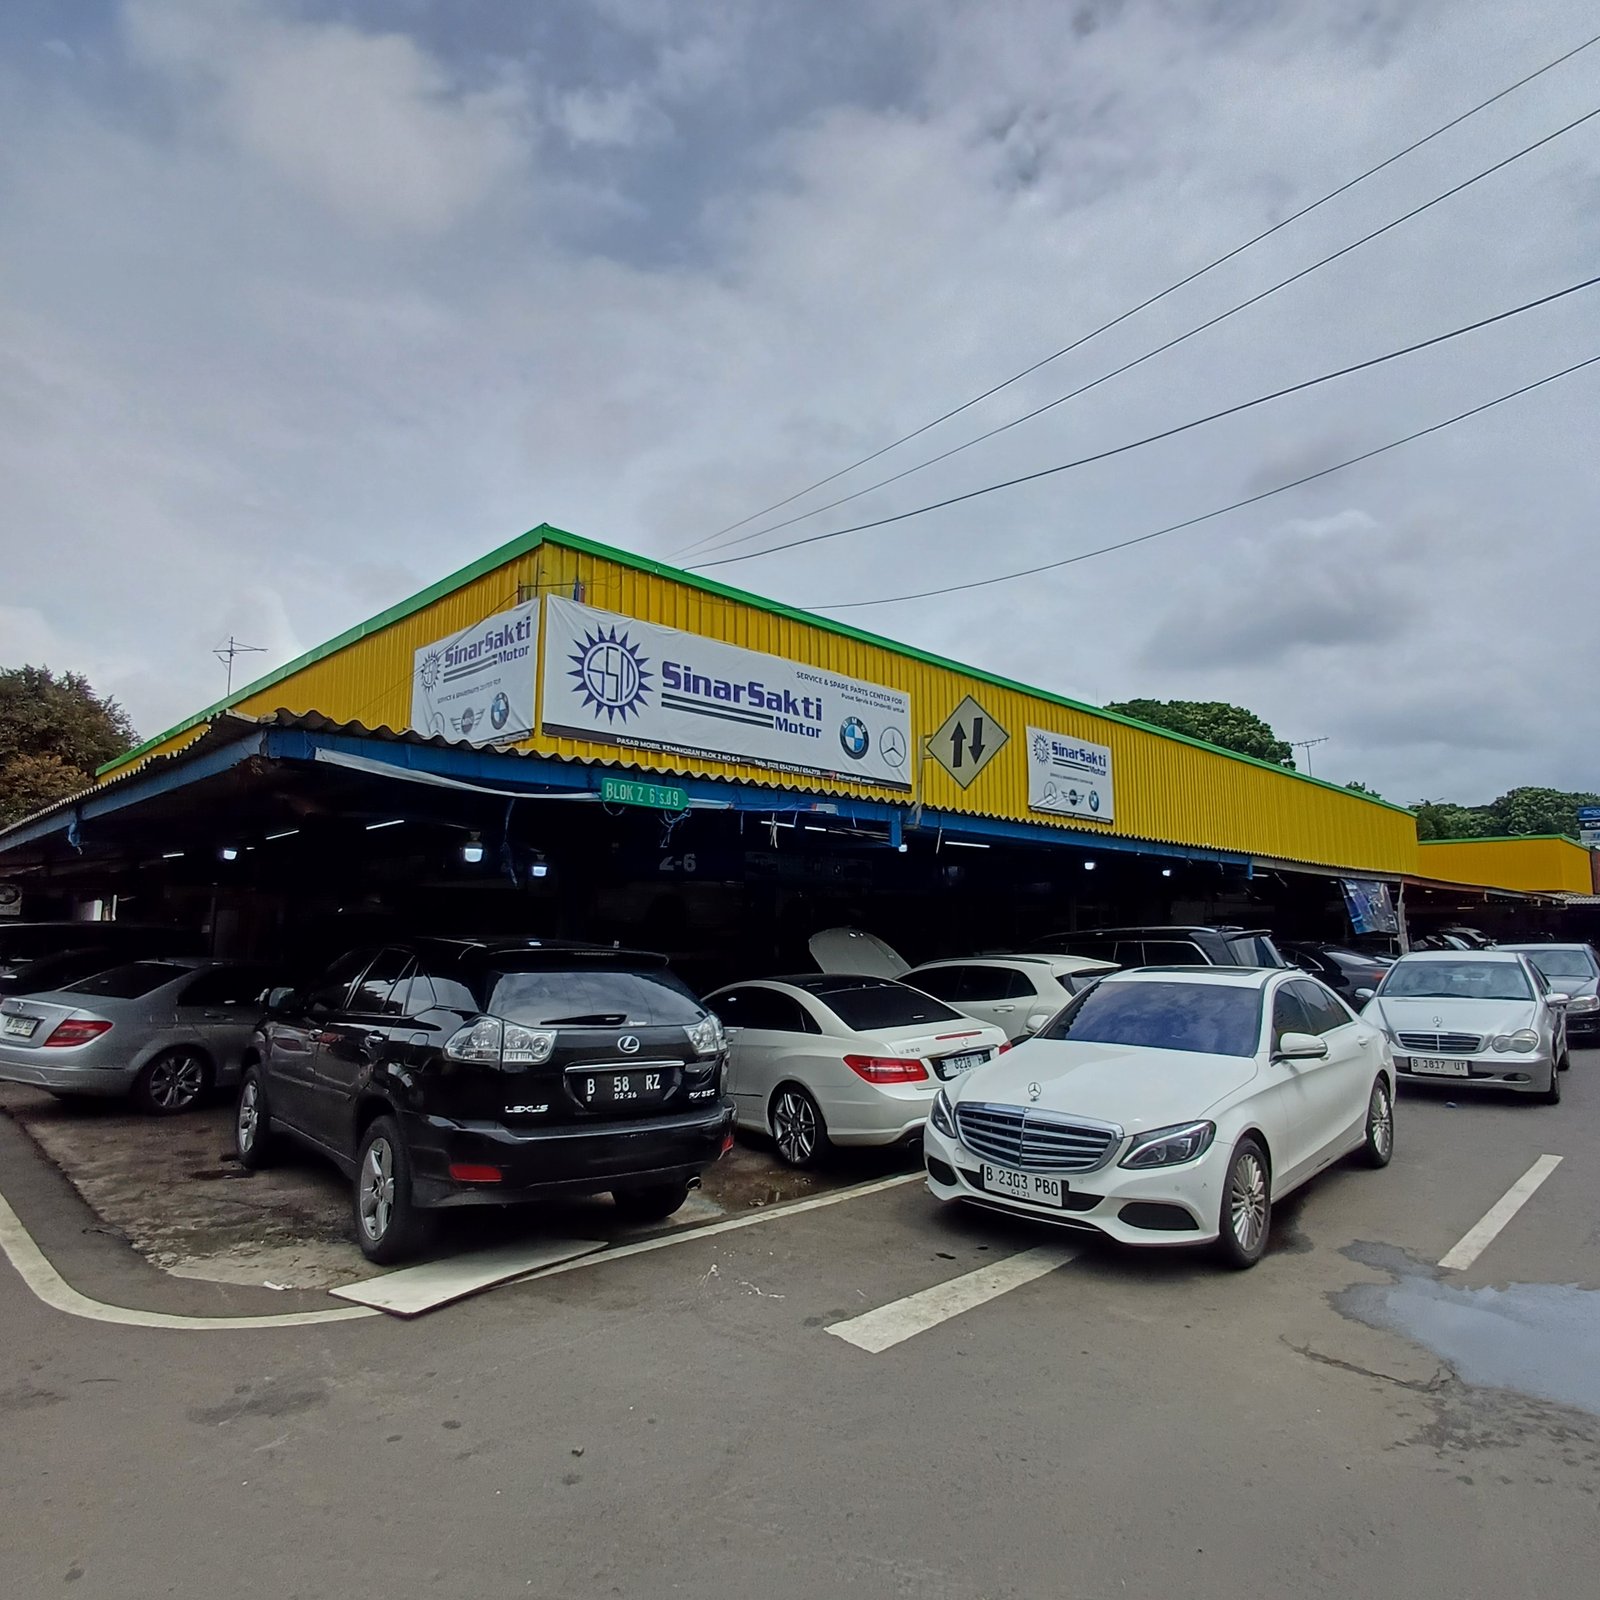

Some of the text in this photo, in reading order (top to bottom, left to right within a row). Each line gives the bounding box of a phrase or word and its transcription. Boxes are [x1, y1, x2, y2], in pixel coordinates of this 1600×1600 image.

[444, 616, 531, 668] SinarSakti
[498, 645, 530, 664] Motor
[662, 660, 822, 721] SinarSakti
[796, 671, 823, 685] SERVICE
[830, 680, 849, 691] SPARE
[850, 685, 868, 697] PARTS
[869, 691, 891, 702] CENTER
[775, 716, 822, 739] Motor
[616, 737, 640, 747] PASAR
[640, 741, 662, 751] MOBIL
[662, 745, 701, 756] KEMAYORAN
[701, 750, 717, 759] BLOK
[1051, 741, 1107, 768] SinarSakti
[606, 781, 634, 801] BLOK
[637, 786, 644, 802] Z
[649, 788, 656, 804] 6
[1413, 1059, 1419, 1068] B
[1454, 1061, 1466, 1071] UT
[586, 1073, 661, 1095] B 58 RZ
[504, 1103, 549, 1114] LEXUS
[986, 1166, 1059, 1197] B 2303 PBO
